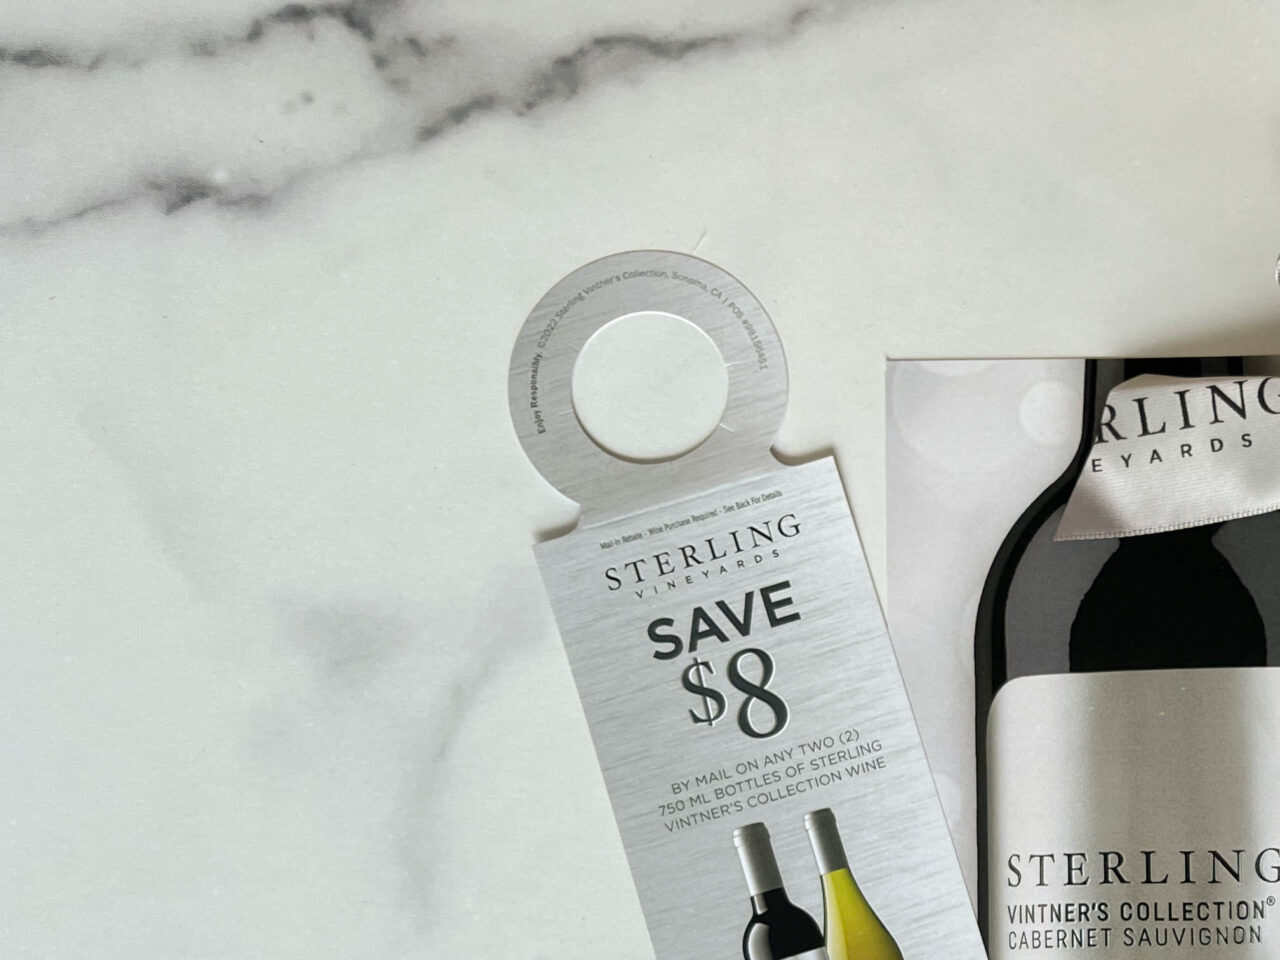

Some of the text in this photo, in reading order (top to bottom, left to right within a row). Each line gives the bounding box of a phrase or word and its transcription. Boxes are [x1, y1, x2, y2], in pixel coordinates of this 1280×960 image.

[555, 293, 586, 320] Sterling
[711, 287, 723, 299] CA
[727, 302, 744, 319] POS
[530, 352, 543, 408] Responsibly.
[534, 409, 546, 435] Enjoy
[1091, 433, 1253, 473] EYARDS
[600, 490, 783, 549] Mail-In Rebate Wine Purchase Required See Back For Details
[605, 513, 801, 591] STERLING
[635, 549, 780, 599] VINEYARDS
[647, 580, 801, 660] SAVE
[681, 648, 790, 739] $8
[658, 740, 883, 817] 750 ML BOTTLES OF STERLING
[671, 729, 860, 795] BY MAIL ON ANY TWO (2)
[664, 756, 887, 833] VINTNER'S COLLECTION WINE
[1007, 902, 1109, 925] VINTNER'S
[1008, 925, 1262, 950] CABERNET SAUVIGNON
